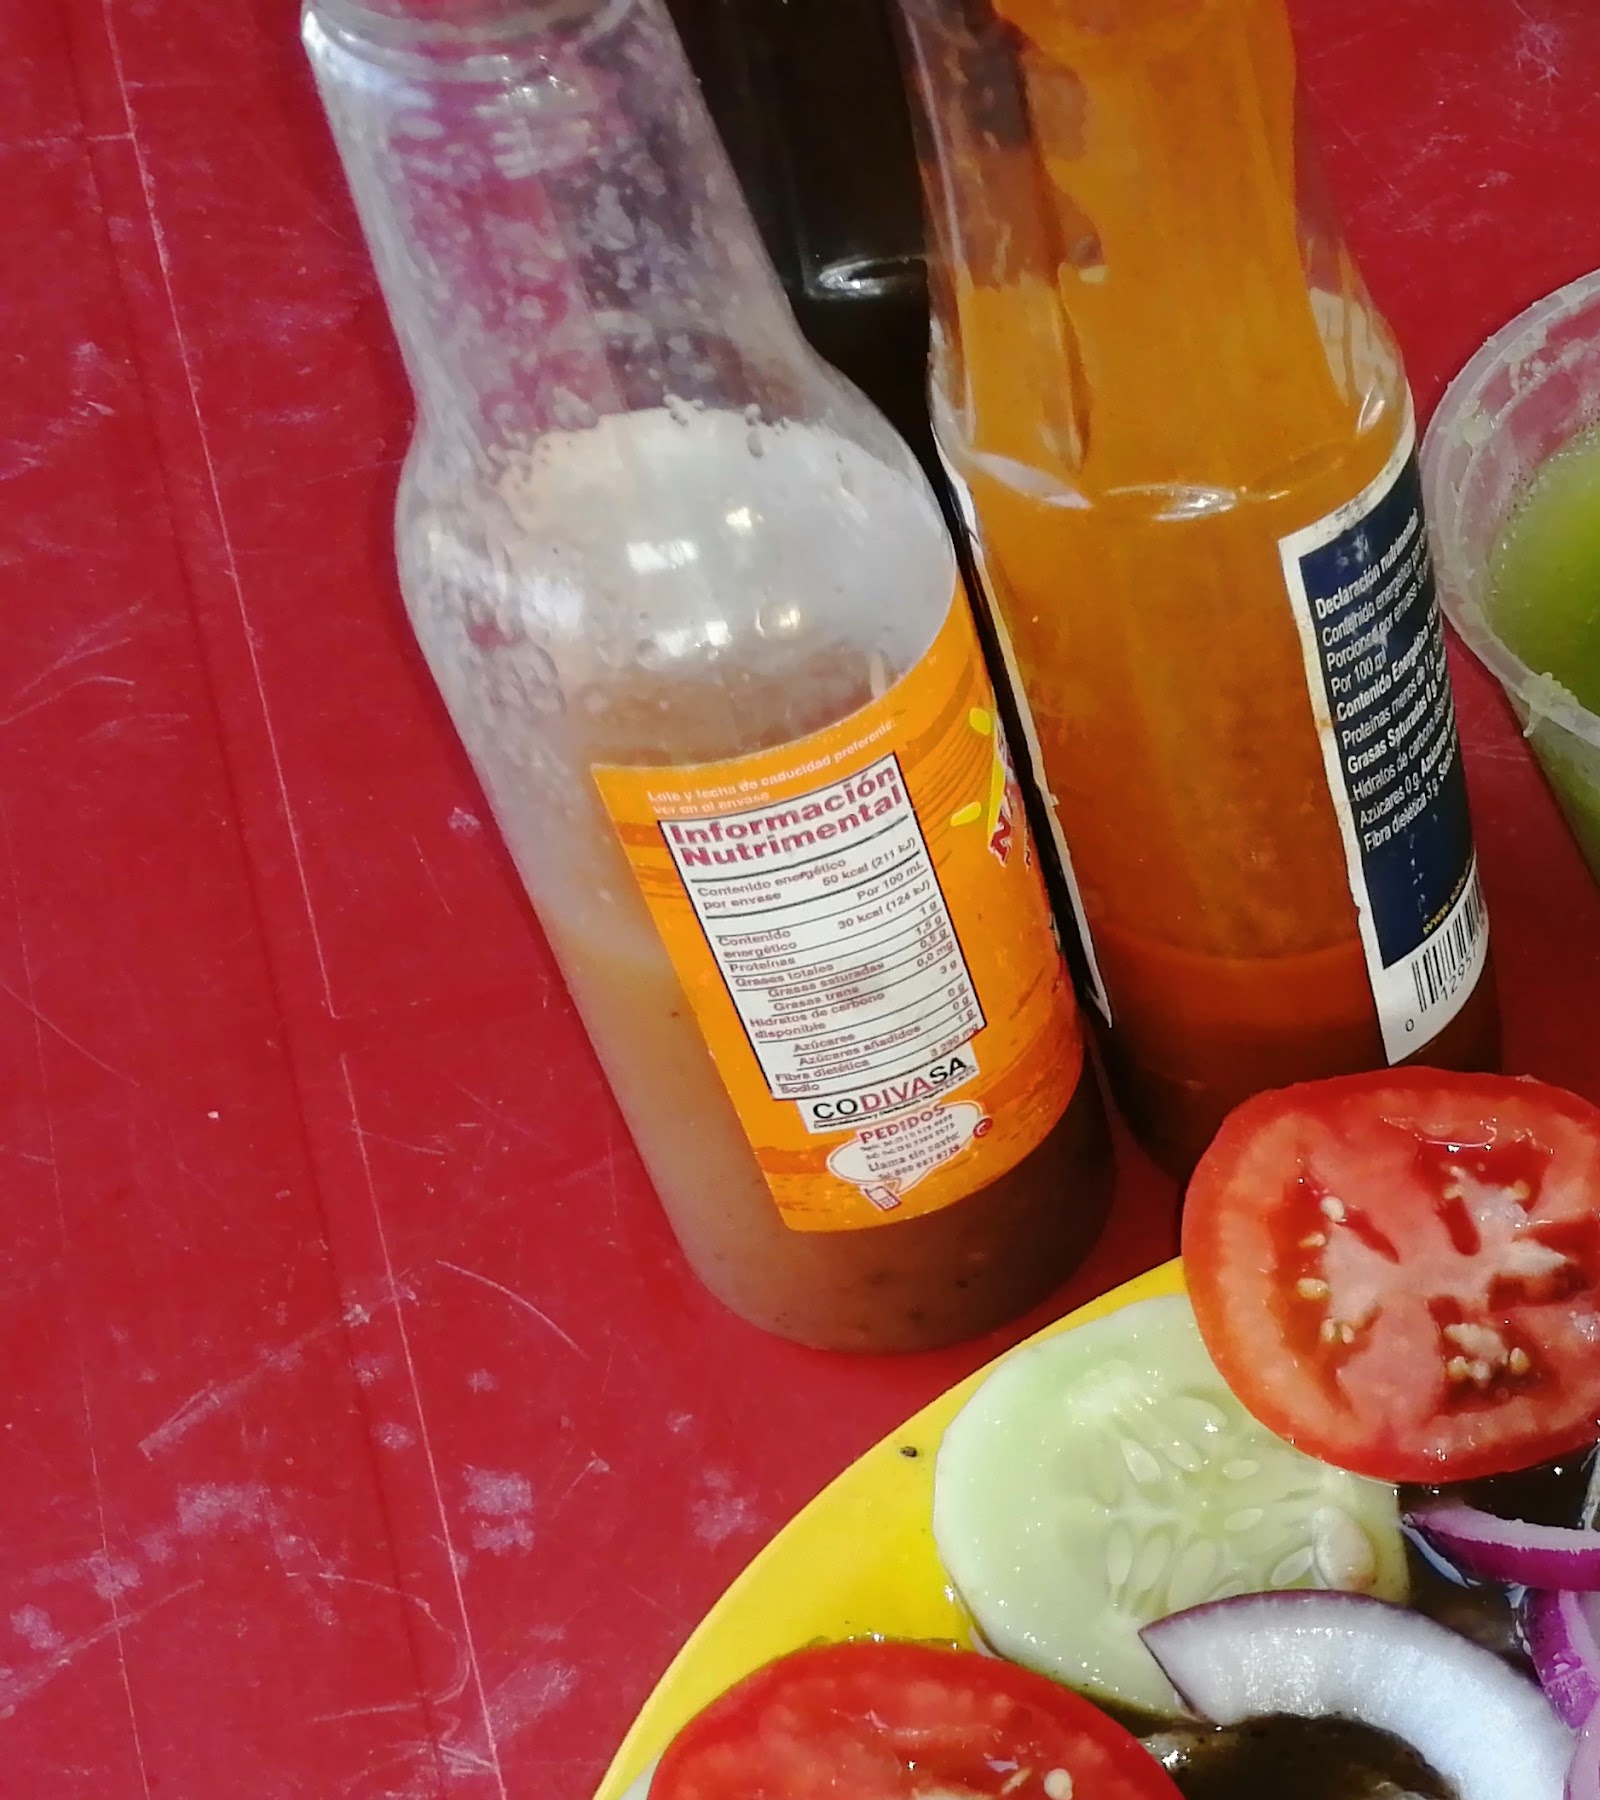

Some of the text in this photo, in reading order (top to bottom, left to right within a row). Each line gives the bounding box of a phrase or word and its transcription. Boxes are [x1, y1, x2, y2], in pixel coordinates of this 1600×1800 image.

[1315, 564, 1381, 620] Declaración
[1322, 602, 1376, 647] Contenido
[1331, 673, 1353, 698] Por
[1353, 655, 1374, 684] 100
[1336, 674, 1392, 721] Contenido
[1391, 678, 1418, 715] menos
[1348, 739, 1388, 774] Grasas
[1387, 695, 1428, 748] Saturadas
[739, 780, 759, 792] de
[761, 755, 832, 786] caducidad
[1352, 763, 1397, 802] Hidratos
[1396, 752, 1409, 772] de
[669, 765, 898, 844] Información
[1360, 784, 1406, 829] Azúcares
[680, 785, 902, 868] Nutrimental
[1364, 824, 1392, 853] Fibra
[697, 858, 847, 898] Contenido energético
[842, 863, 870, 880] kcal
[857, 885, 881, 902] Por
[884, 873, 904, 893] 100
[703, 891, 782, 913] por envase
[857, 904, 884, 923] kcal
[717, 928, 792, 948] Contenido
[723, 940, 798, 960] energético
[729, 956, 797, 974] Proteínas
[735, 972, 785, 988] Grasas
[787, 962, 834, 980] totales
[768, 982, 817, 998] Grasas
[819, 962, 886, 987] saturadas
[750, 991, 886, 1029] Hidratos de carbono
[773, 992, 822, 1012] Grasas
[825, 984, 861, 1001] trans
[754, 1021, 828, 1041] disponible
[793, 1032, 857, 1053] Azúcares
[1405, 1018, 1415, 1032] 0
[799, 1045, 861, 1066] Azúcares
[863, 1023, 922, 1052] añadidos
[774, 1070, 811, 1084] Fibra
[812, 1057, 871, 1079] dietética
[780, 1081, 821, 1095] Sodio
[812, 1056, 968, 1120] CODIVASA
[859, 1102, 946, 1145] PEDIDOS
[868, 1156, 907, 1173] Llama
[908, 1148, 926, 1162] sin
